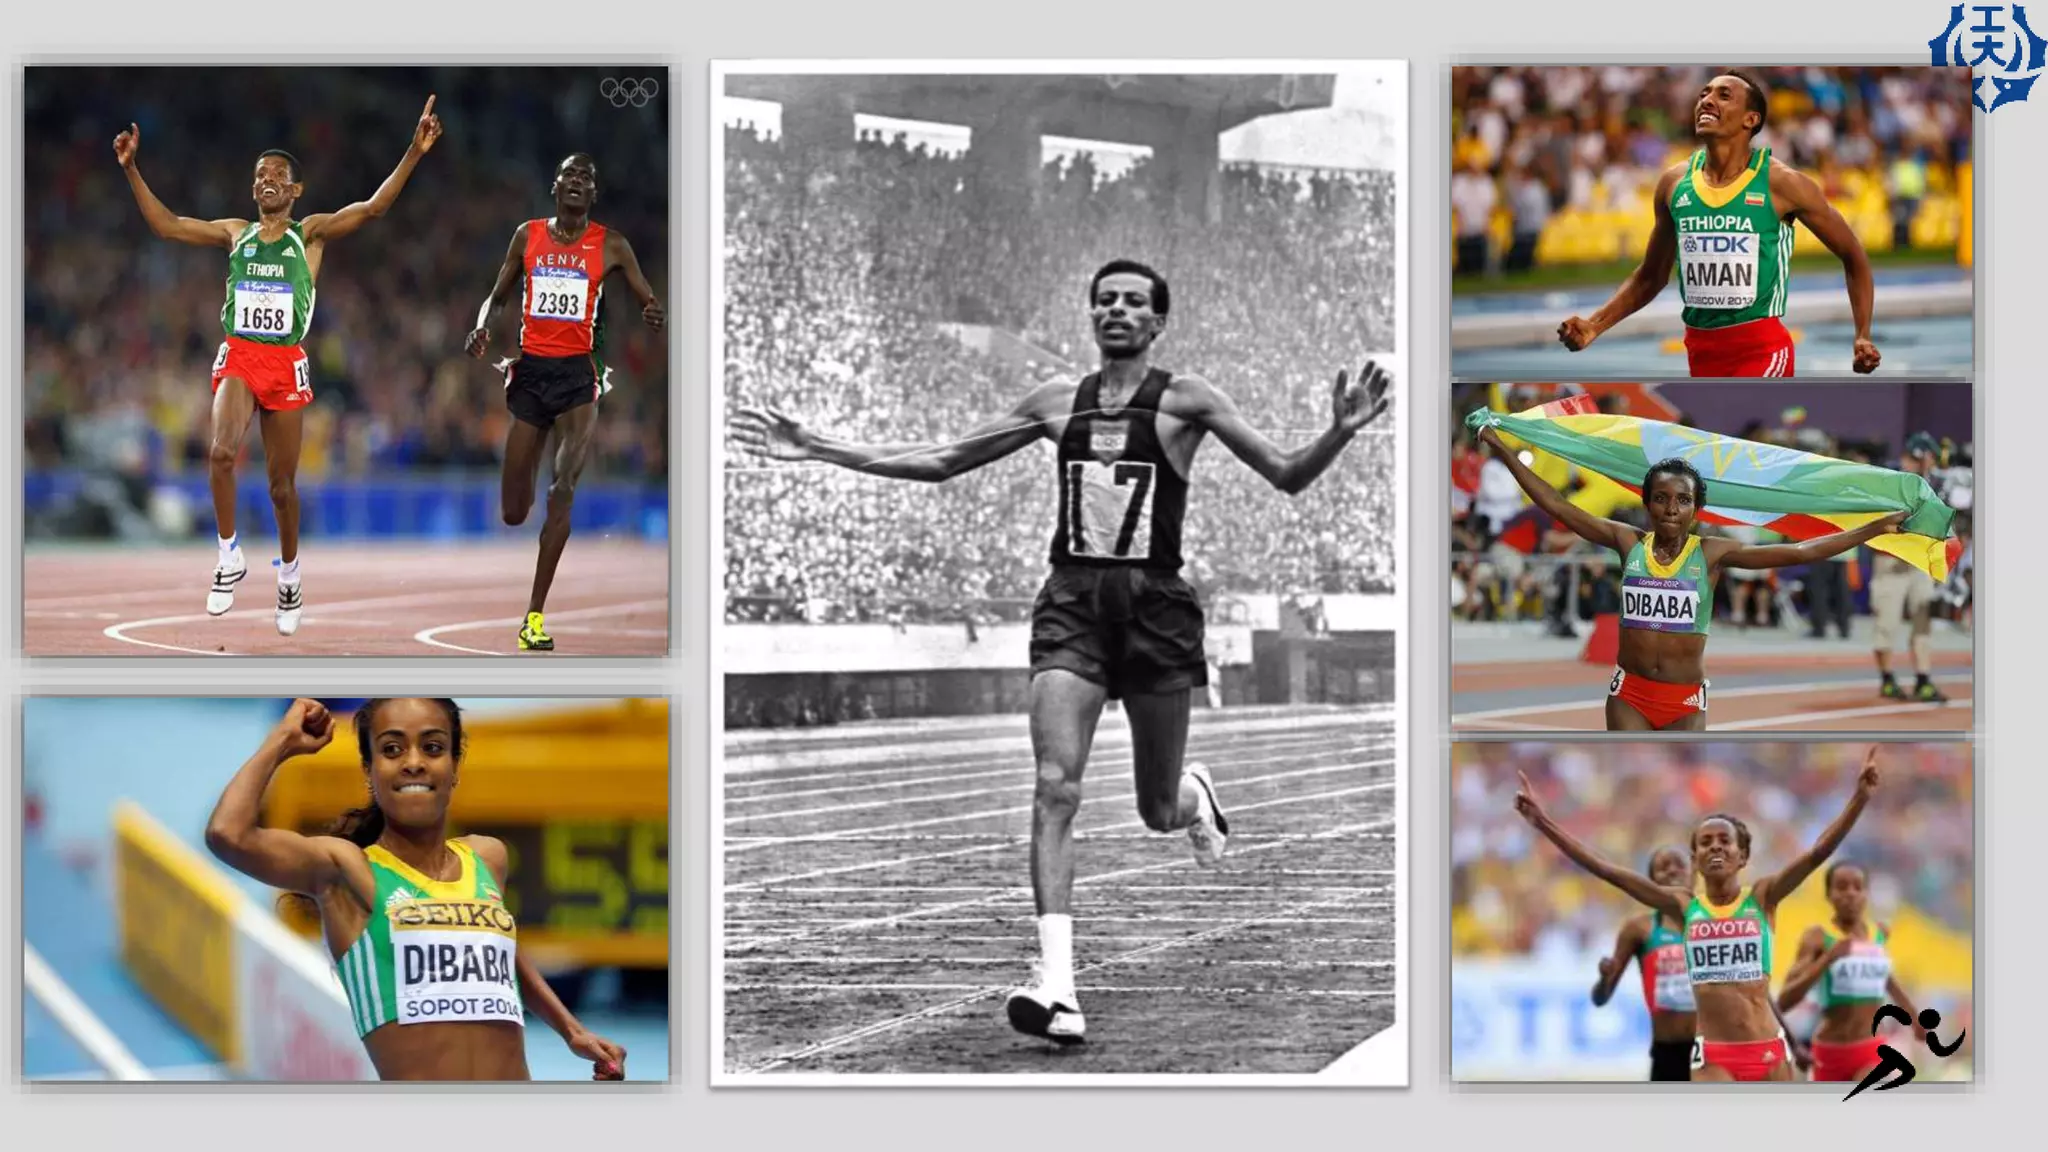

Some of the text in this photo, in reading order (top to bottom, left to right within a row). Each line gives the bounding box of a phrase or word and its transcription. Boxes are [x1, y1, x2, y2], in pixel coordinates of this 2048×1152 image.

[1679, 214, 1754, 232] ETHIOPIA
[1696, 236, 1749, 254] TDK
[246, 262, 285, 278] ETHIOPIA
[536, 253, 586, 271] KENYA
[1686, 262, 1752, 287] AMAN
[538, 291, 579, 316] 2393
[241, 307, 285, 331] 1658
[1070, 463, 1154, 557] 17
[1638, 577, 1680, 589] London 2012
[1624, 591, 1694, 620] DIBABA
[396, 902, 514, 933] SEIKO
[1690, 920, 1759, 938] TOYOTA
[1693, 941, 1758, 968] DEFAR
[403, 944, 514, 990] DIBABA
[406, 997, 521, 1019] SOPOT 2014
